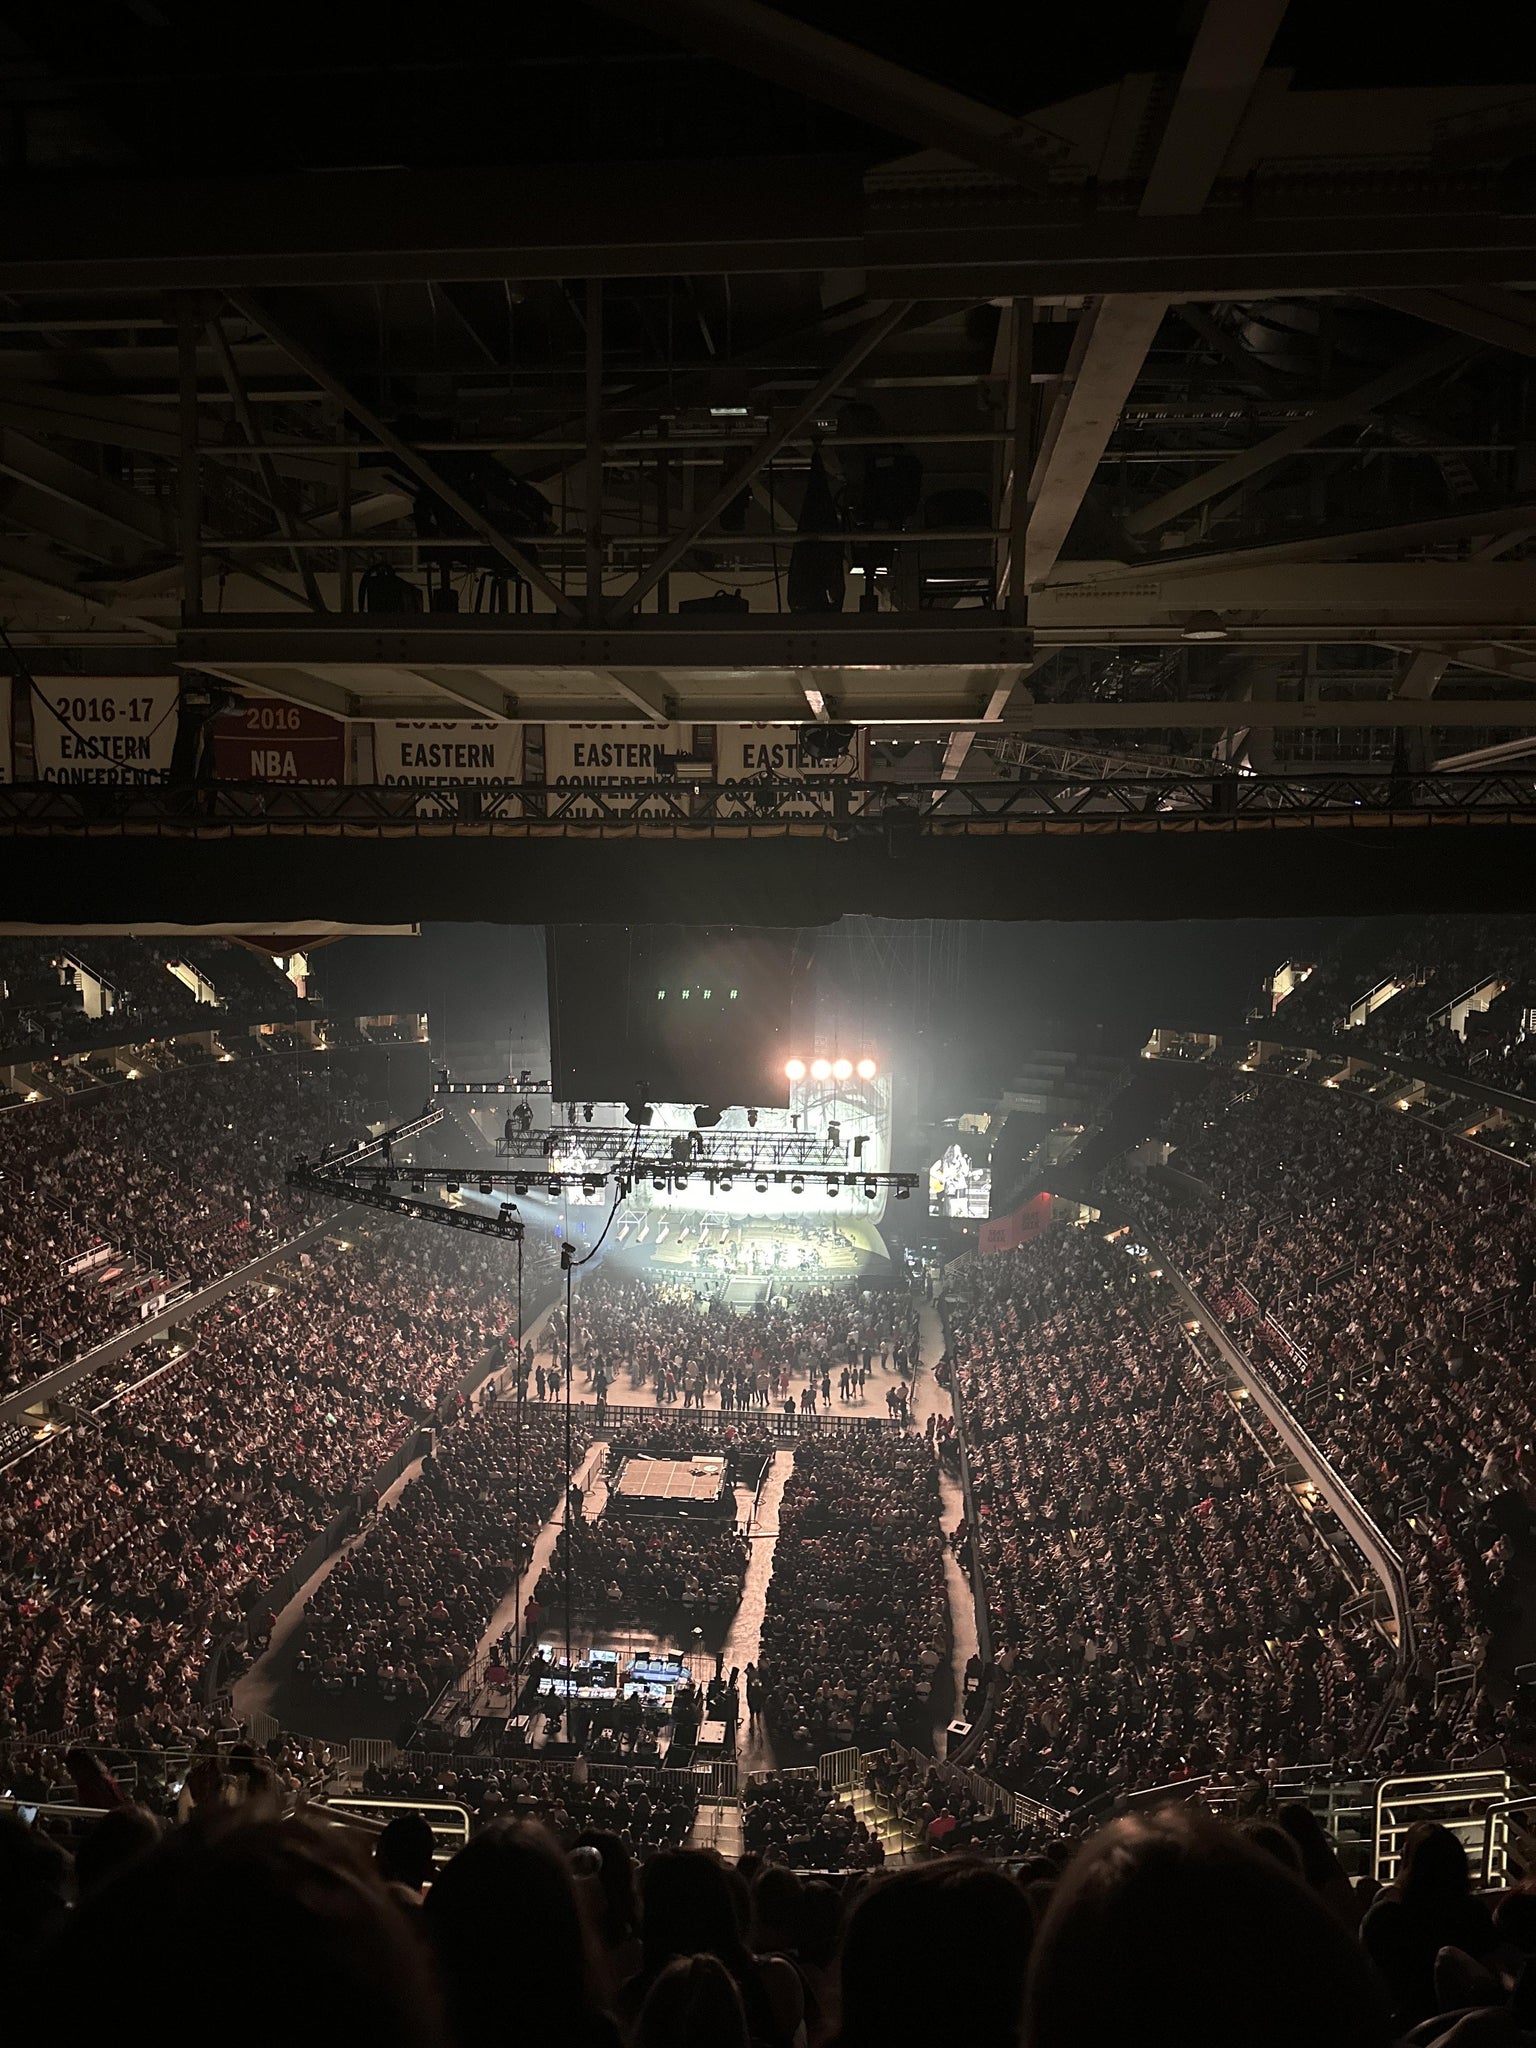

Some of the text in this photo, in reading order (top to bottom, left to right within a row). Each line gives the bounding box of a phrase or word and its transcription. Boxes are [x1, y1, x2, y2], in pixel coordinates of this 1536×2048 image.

[57, 698, 153, 722] 2016-17
[246, 708, 300, 730] 2016
[61, 735, 150, 759] EASTERN
[401, 743, 495, 767] EASTERN
[251, 750, 298, 777] NBA
